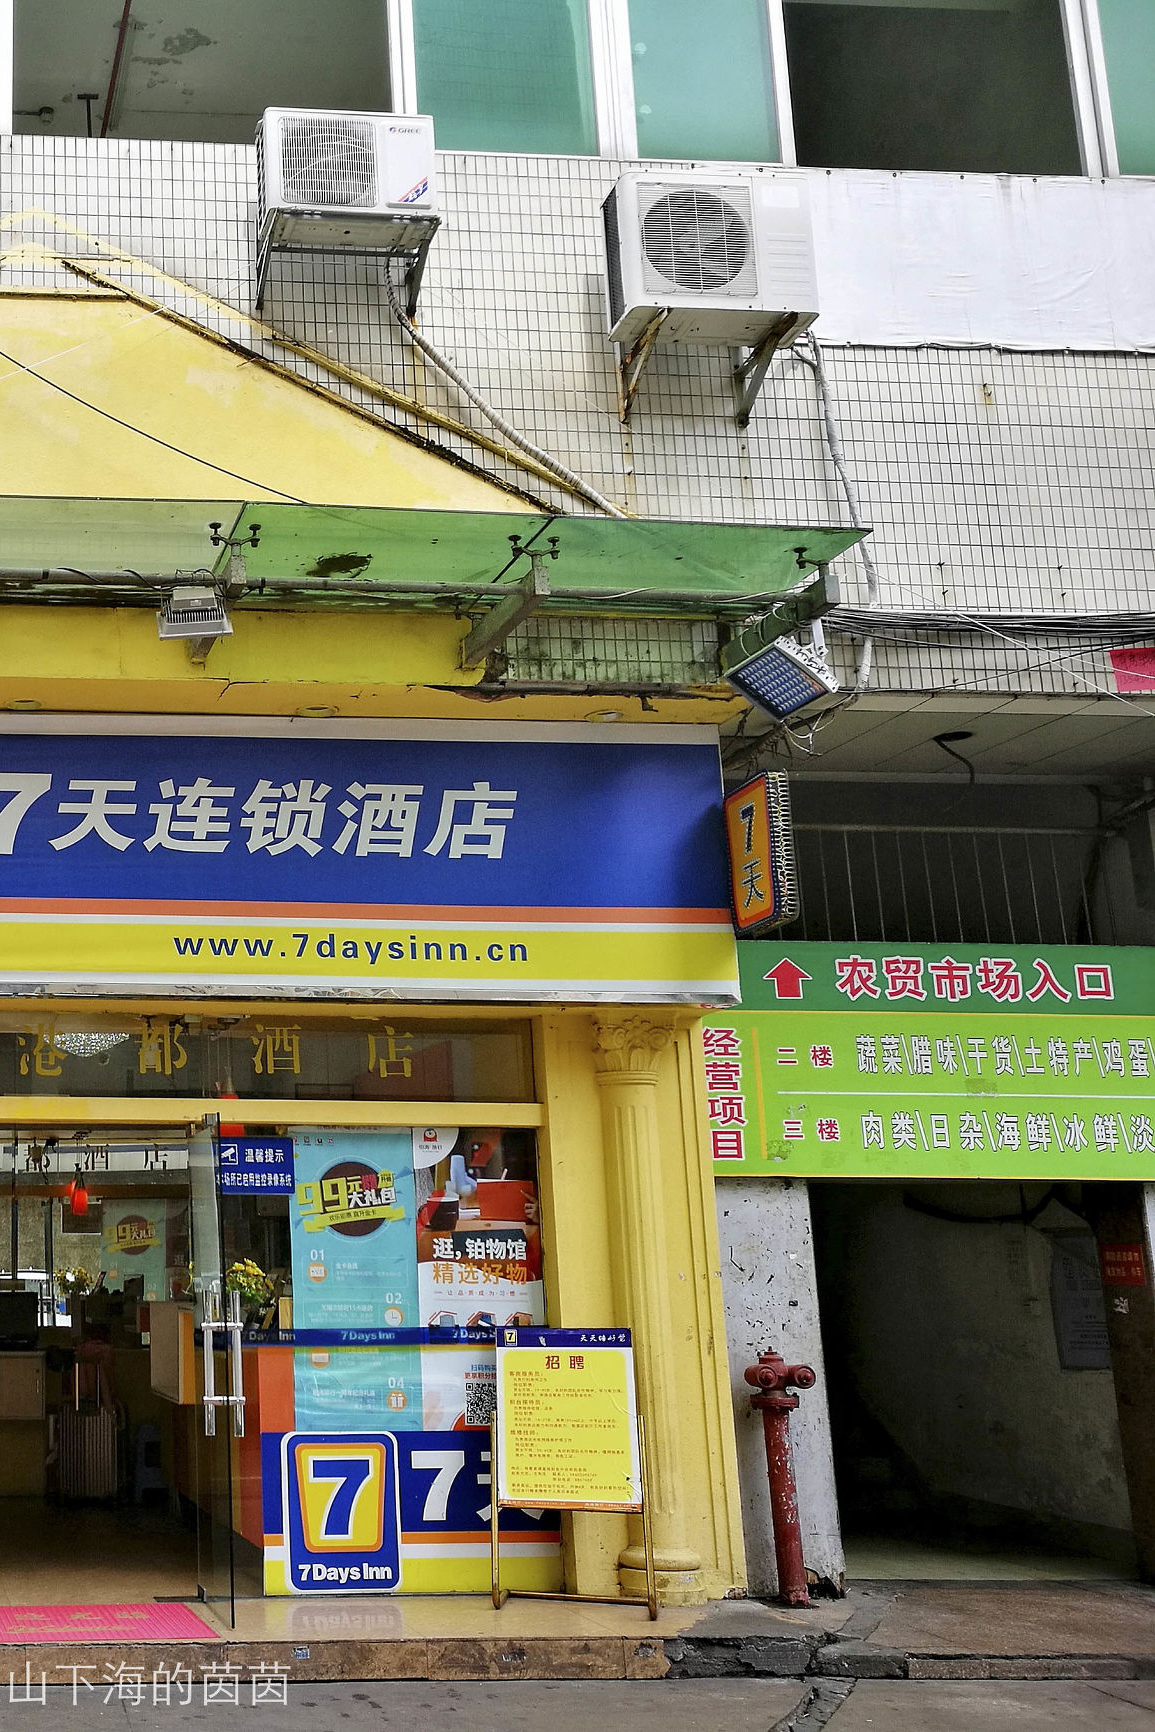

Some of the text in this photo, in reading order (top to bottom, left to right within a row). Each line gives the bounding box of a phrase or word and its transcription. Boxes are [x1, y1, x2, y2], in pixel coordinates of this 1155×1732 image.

[739, 801, 764, 909] 7天
[173, 932, 529, 963] www.7daysinn.cn
[835, 955, 1115, 1003] 农贸市场入口
[17, 1022, 416, 1078] 港都酒店
[776, 1044, 835, 1068] 二楼
[702, 1026, 747, 1161] 经营项目
[783, 1118, 841, 1141] 三楼
[245, 1148, 284, 1163] 温馨提示
[310, 1249, 325, 1260] 01
[432, 1262, 527, 1285] 精选好物
[386, 1292, 402, 1304] 02
[349, 1331, 377, 1342] Days
[379, 1331, 395, 1339] Inn
[546, 1355, 584, 1369] 招聘
[388, 1377, 405, 1388] 04
[309, 1456, 373, 1540] 7
[298, 1562, 393, 1583] 7 Days Inn
